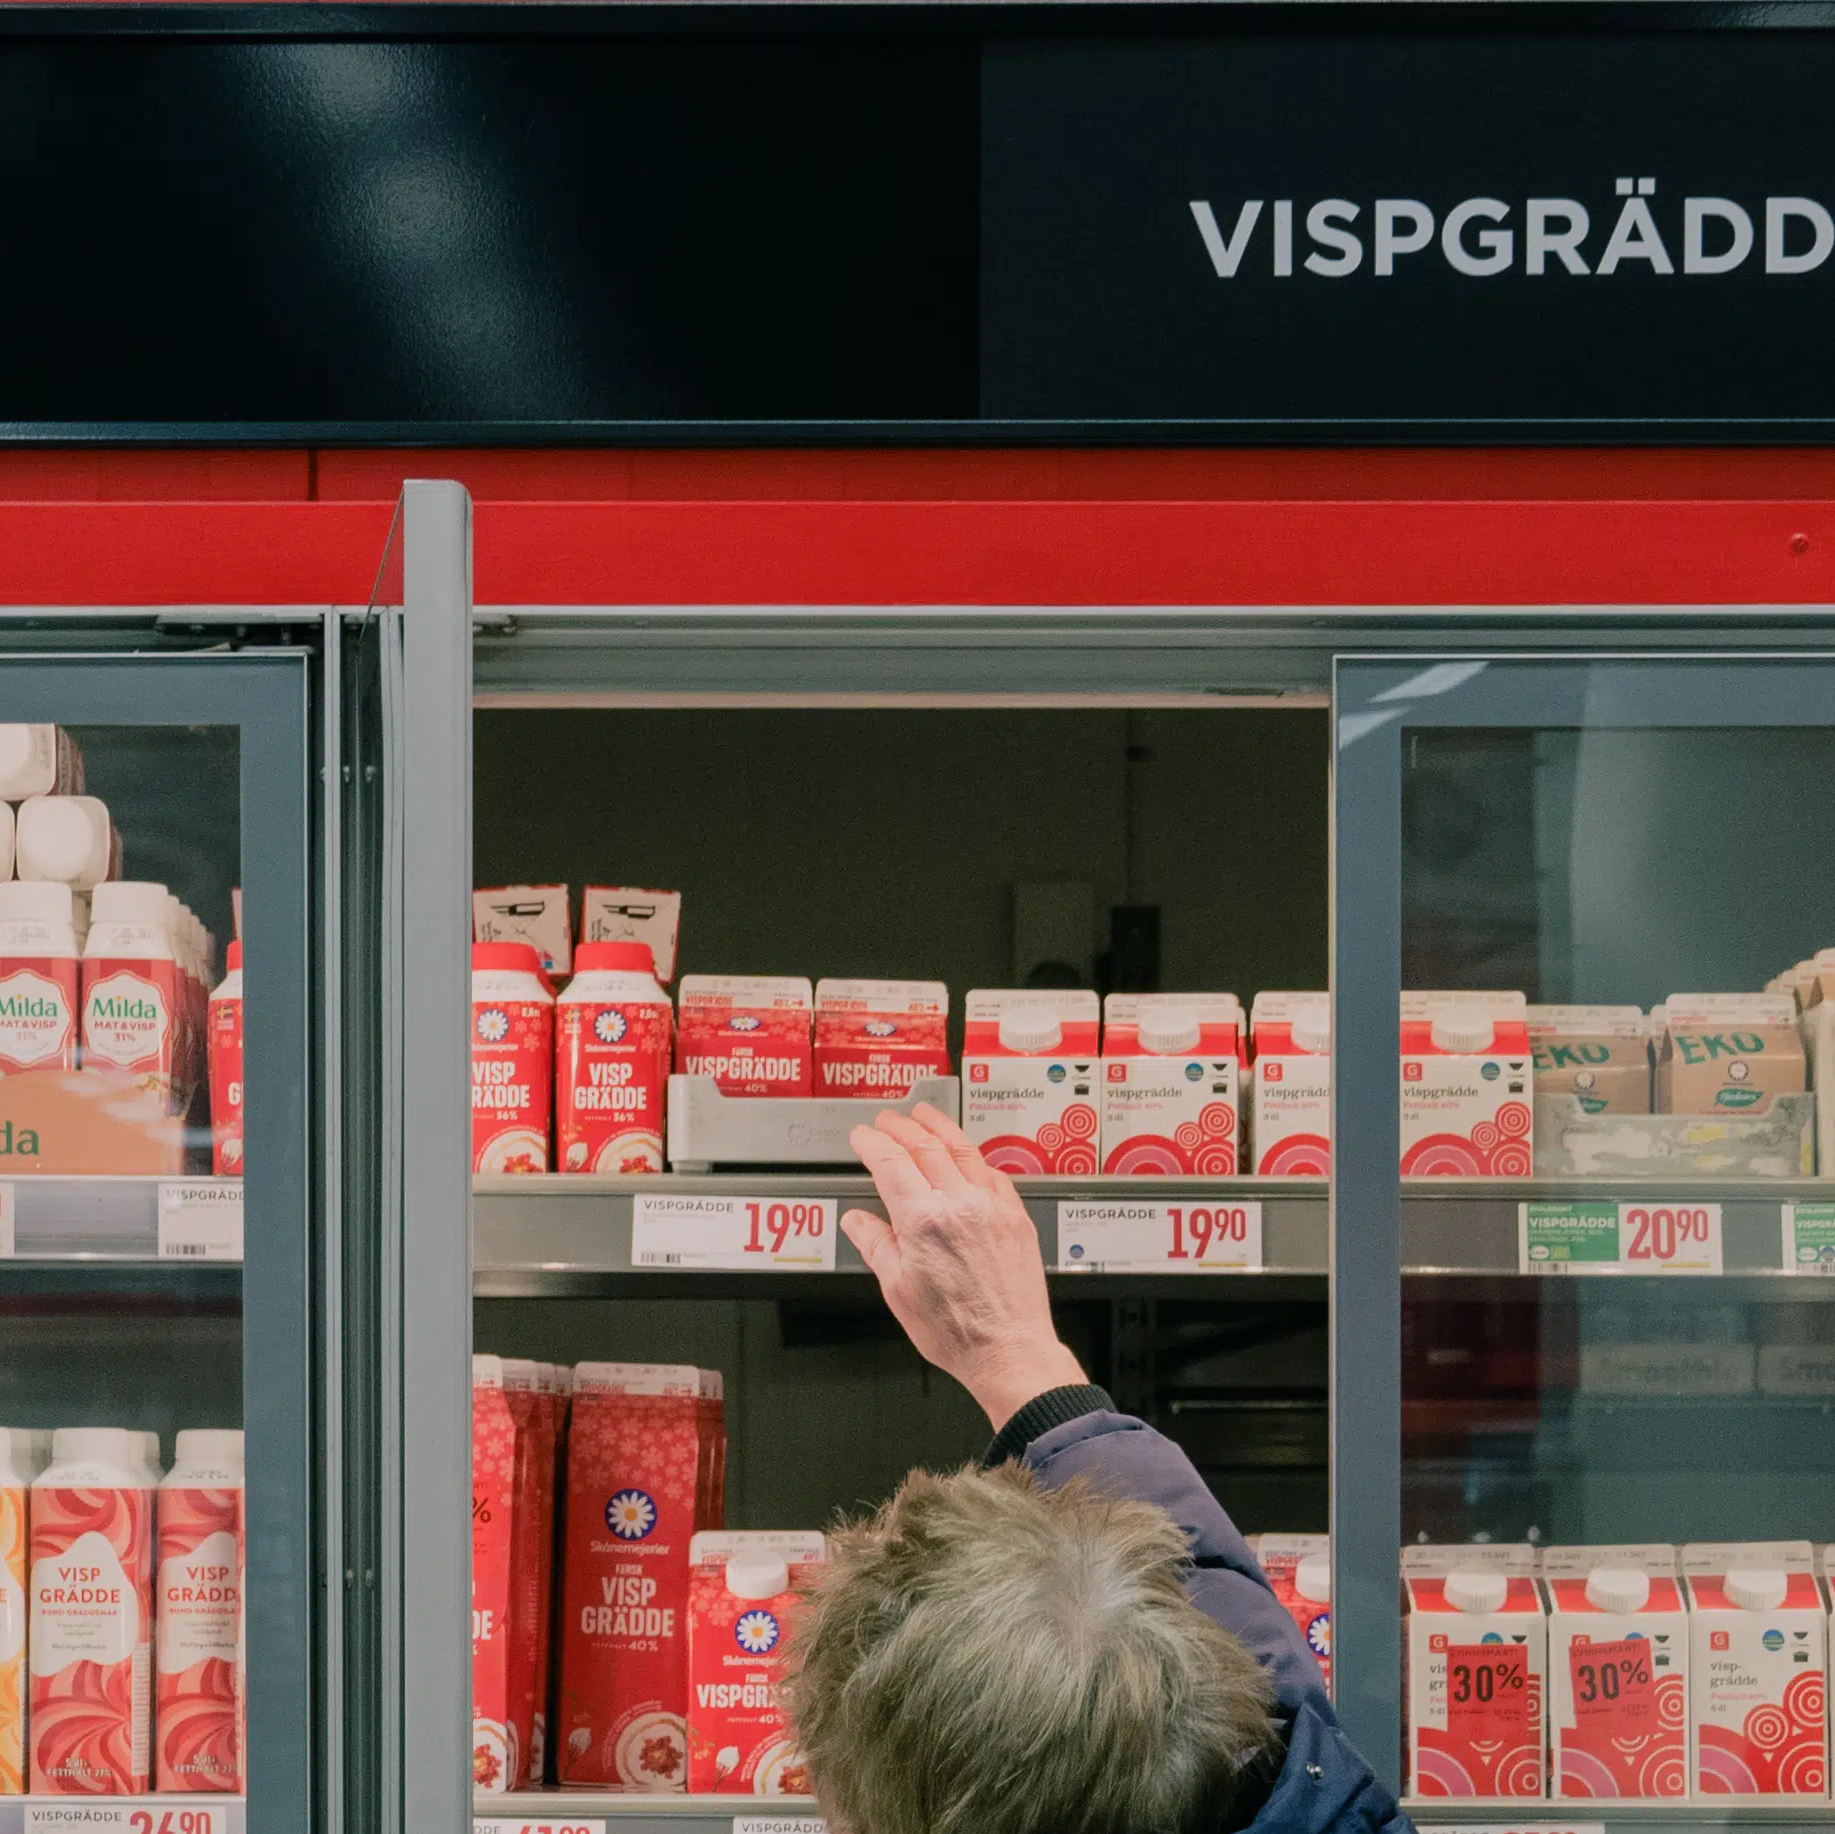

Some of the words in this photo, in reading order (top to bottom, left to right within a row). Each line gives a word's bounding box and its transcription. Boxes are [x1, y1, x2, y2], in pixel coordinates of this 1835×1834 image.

[1675, 1028, 1765, 1065] EKO
[589, 1063, 632, 1086] VISP
[686, 1054, 801, 1082] VISPGRÄDDE
[575, 1085, 646, 1110] GRÄDDE
[970, 1087, 1044, 1101] vispgrädde
[1403, 1084, 1479, 1100] vispgrädde
[644, 1200, 734, 1213] VISPGRÄDDE
[743, 1203, 824, 1253] 1990
[1065, 1206, 1156, 1220] VISPGRÄDDE
[1167, 1208, 1247, 1258] 1990
[1529, 1216, 1615, 1228] VISPGRÄDDE
[1626, 1209, 1709, 1260] 2090
[58, 1568, 101, 1582] VISP
[40, 1584, 120, 1603] GRÄDDE
[601, 1577, 656, 1605] VISP
[581, 1603, 674, 1637] GRÄDDE
[628, 1640, 659, 1652] 40%
[1453, 1663, 1524, 1702] 30%
[1578, 1659, 1649, 1702] 30%
[32, 1809, 122, 1823] VISPGRÄDDE
